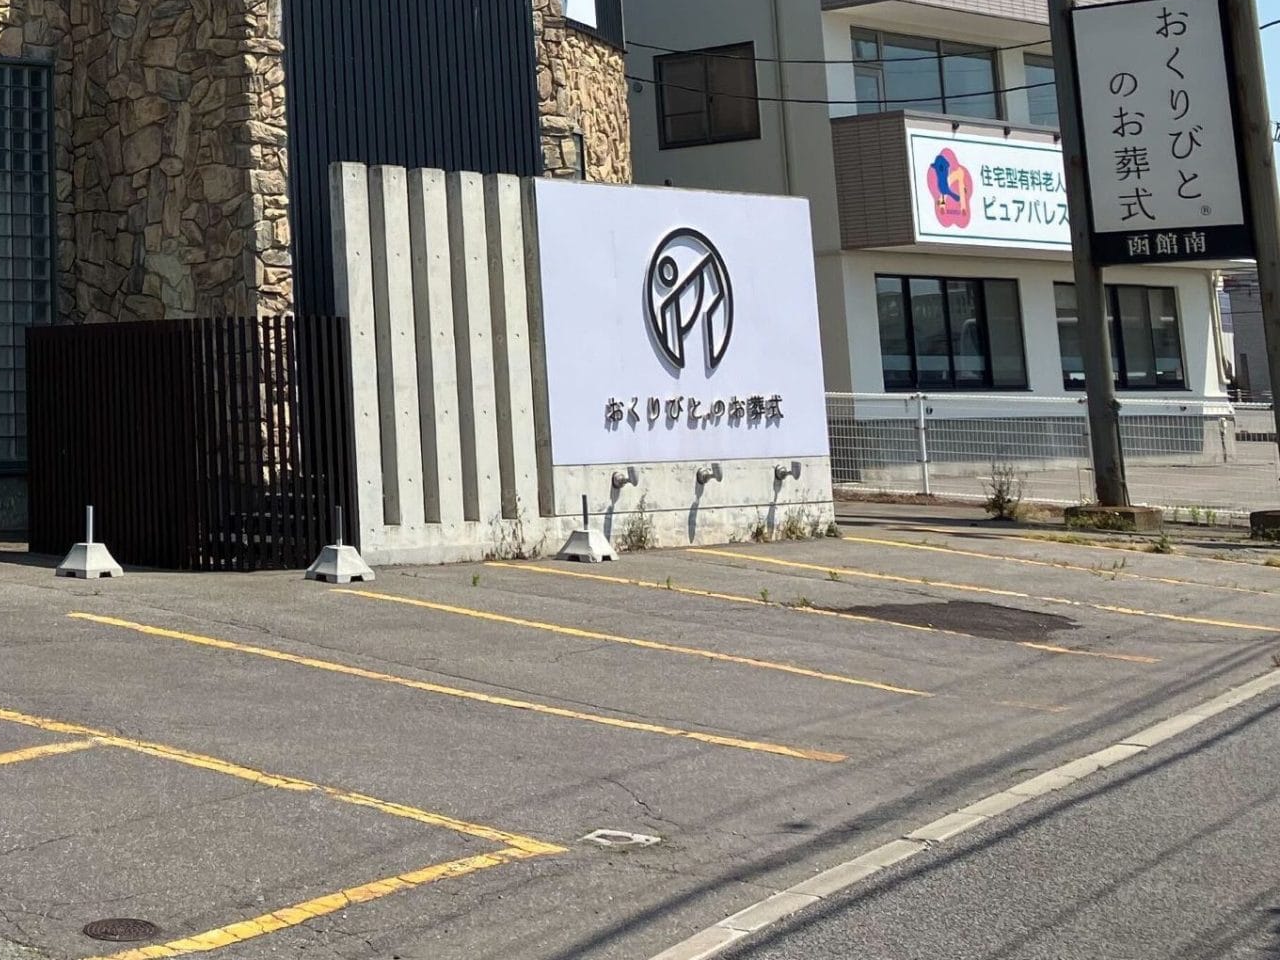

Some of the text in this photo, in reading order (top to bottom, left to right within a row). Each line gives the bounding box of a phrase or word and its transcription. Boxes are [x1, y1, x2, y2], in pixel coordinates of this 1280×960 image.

[1110, 72, 1156, 222] のお葬式
[981, 165, 1067, 193] 住宅型有料老人
[1127, 231, 1207, 257] 函館南
